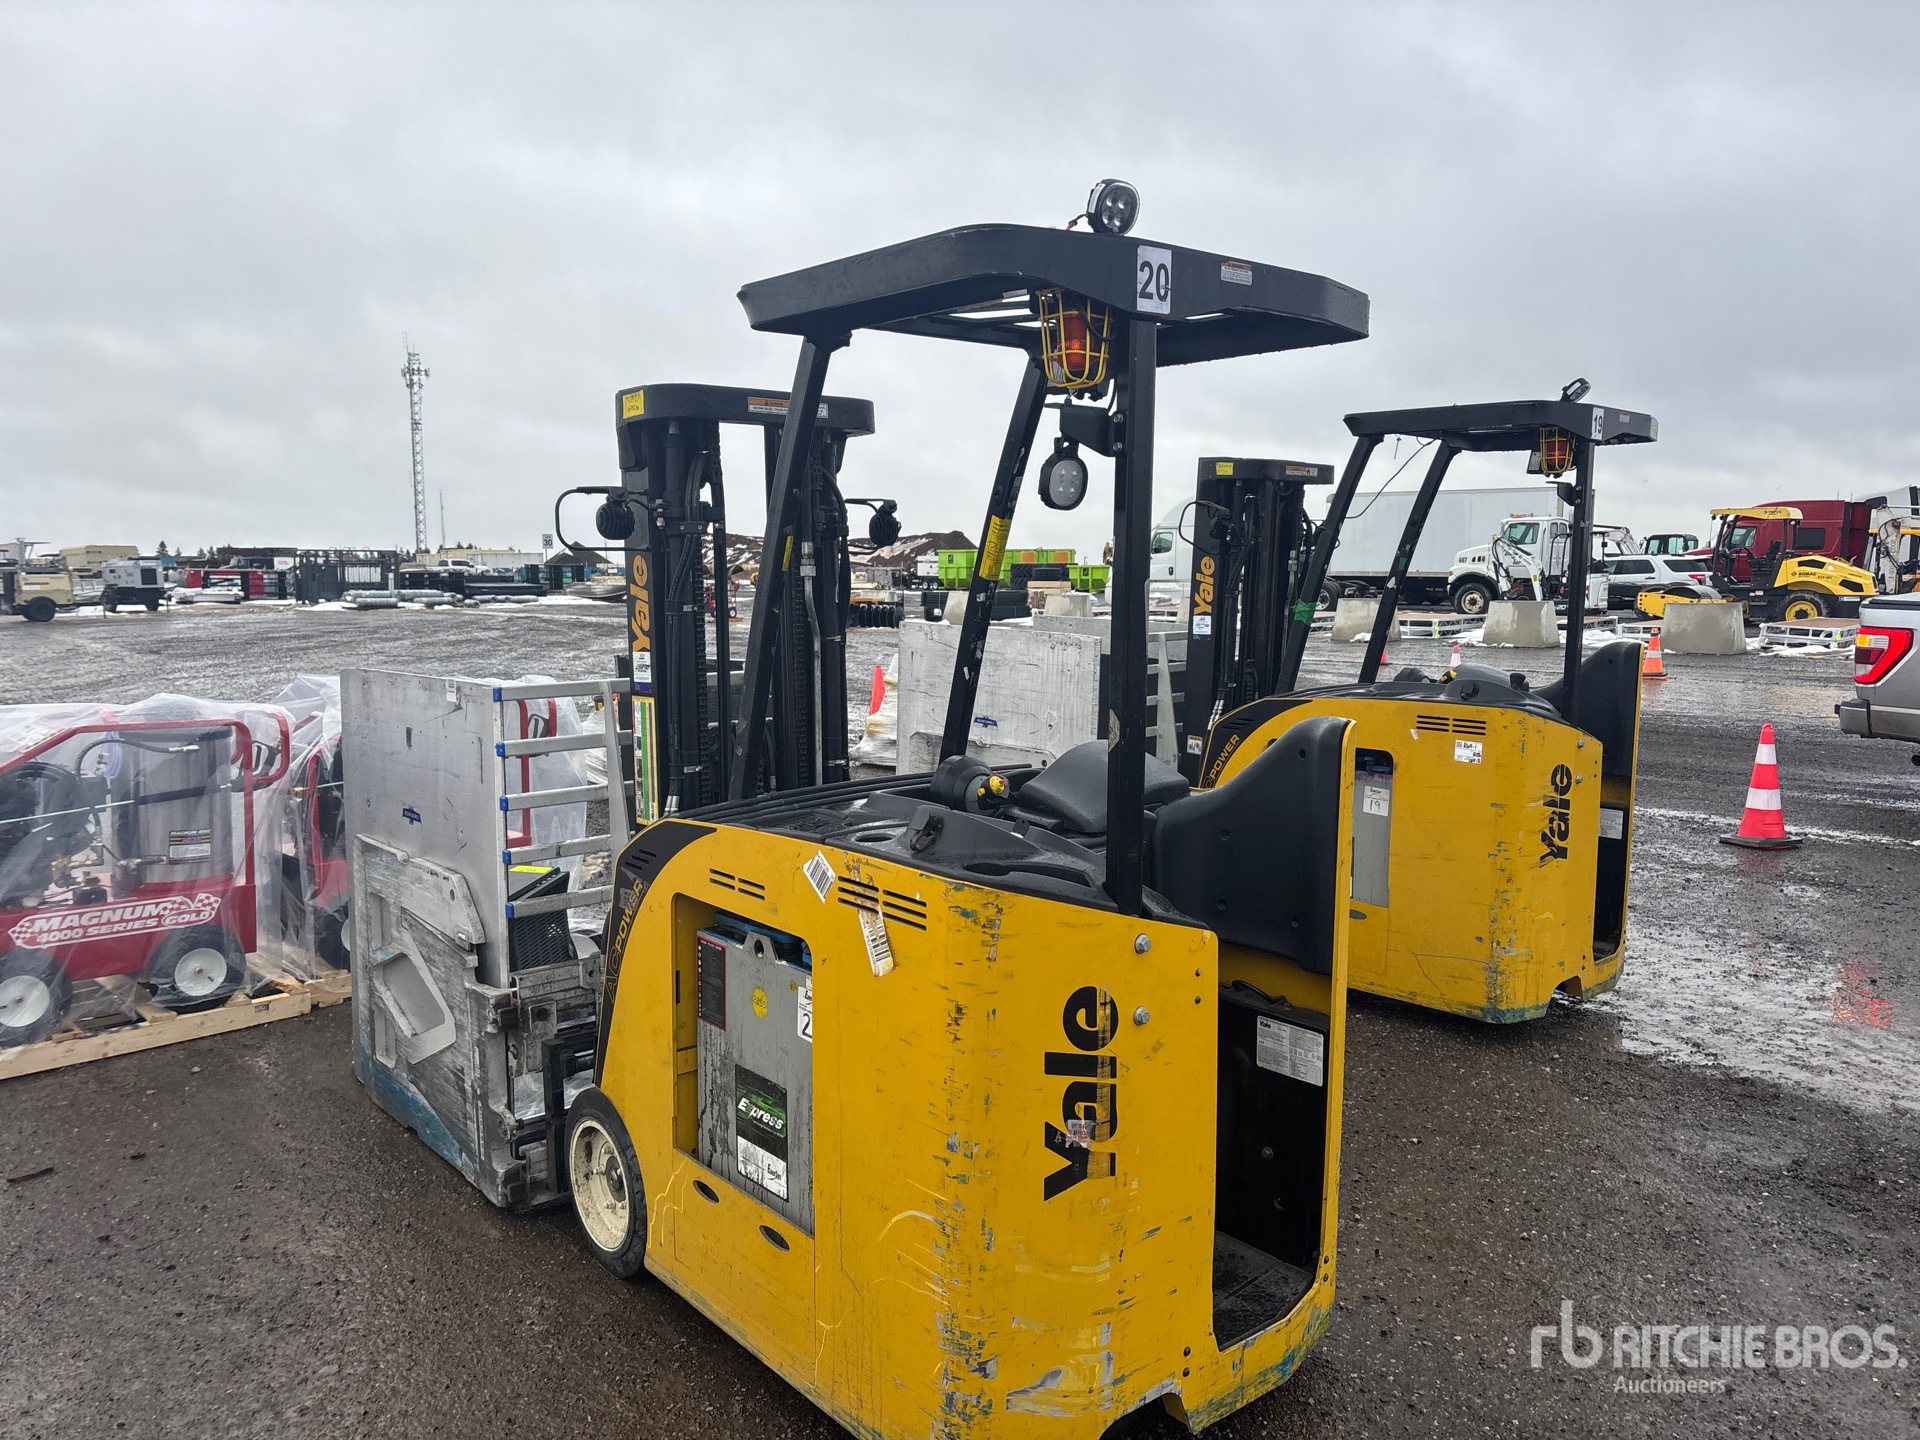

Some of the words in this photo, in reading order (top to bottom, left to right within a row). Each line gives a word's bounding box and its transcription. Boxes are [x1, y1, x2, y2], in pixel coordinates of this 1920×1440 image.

[1138, 260, 1170, 302] 20
[1593, 414, 1603, 434] 19
[543, 538, 553, 547] 30
[1193, 556, 1216, 615] Yale
[629, 554, 651, 652] Yale
[1538, 763, 1573, 868] Yale
[32, 902, 169, 932] MAGNUM
[36, 928, 85, 944] 4000
[84, 917, 159, 937] SERIES
[165, 911, 213, 926] GOLD
[1259, 1020, 1272, 1030] Yale
[1043, 985, 1119, 1201] Yale
